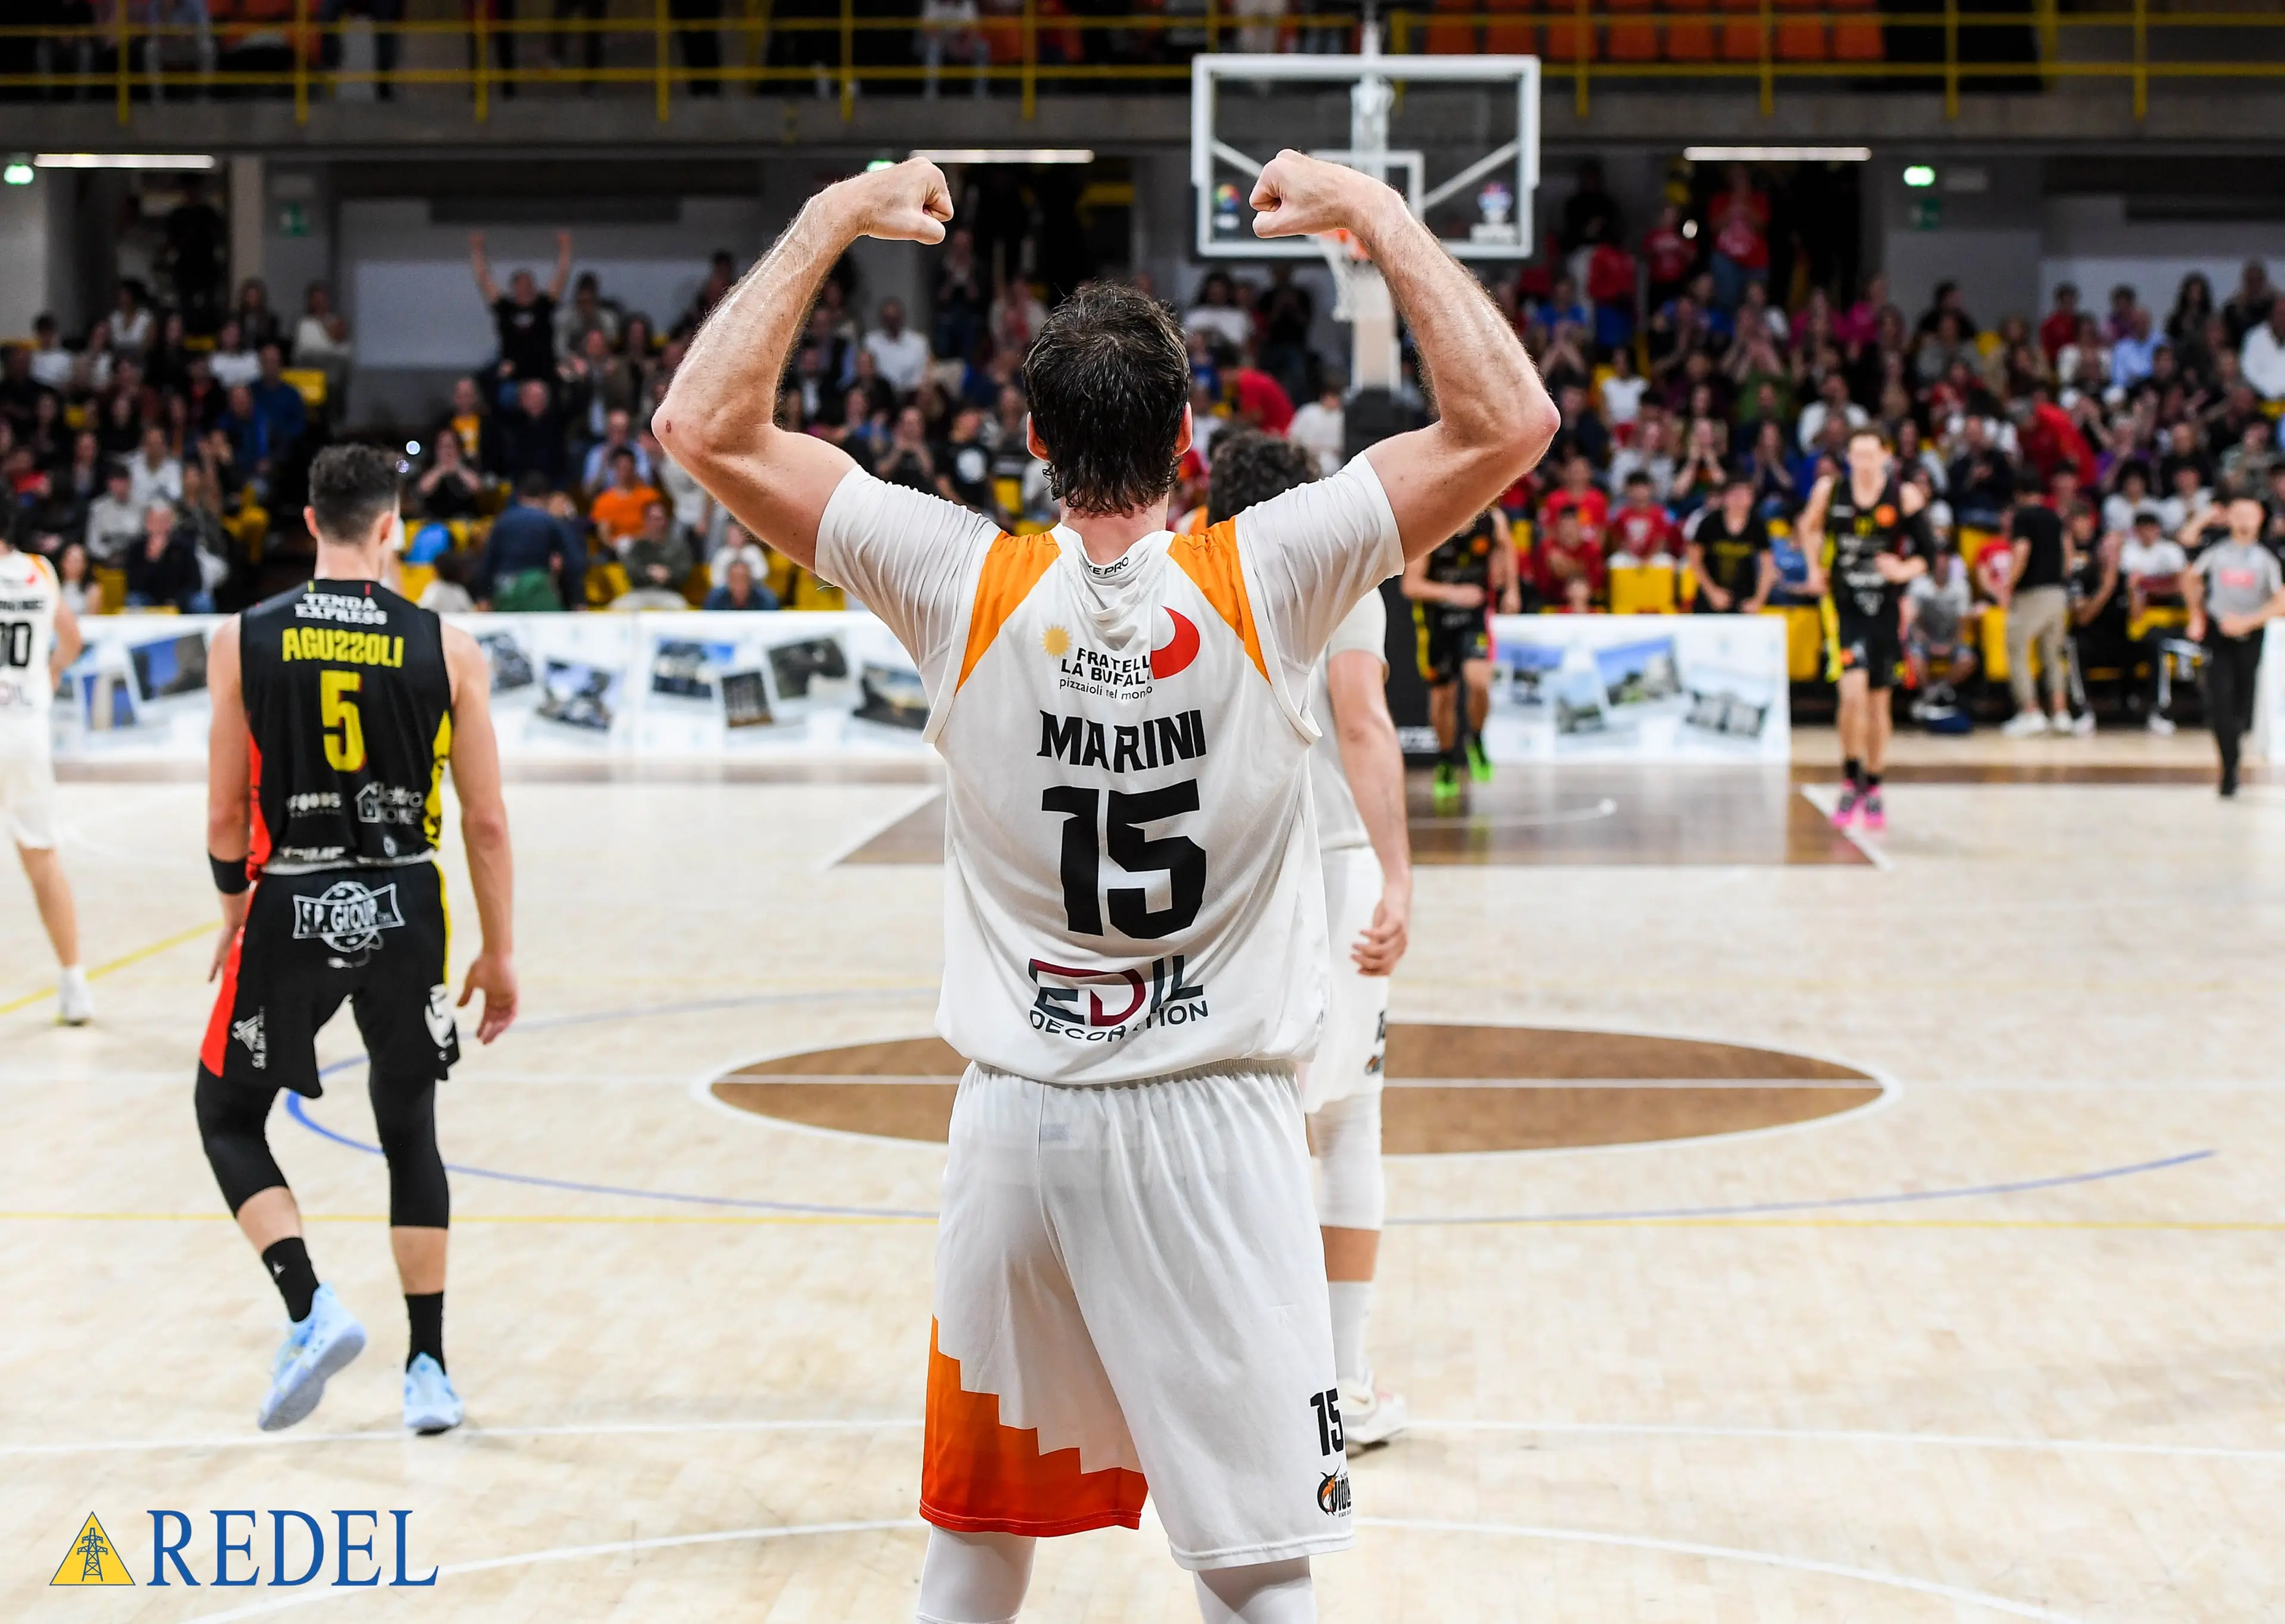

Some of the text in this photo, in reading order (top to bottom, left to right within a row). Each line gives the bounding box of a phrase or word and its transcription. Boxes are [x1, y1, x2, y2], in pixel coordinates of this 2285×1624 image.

[1104, 557, 1128, 575] PRO
[295, 603, 387, 625] EXPRESS
[303, 593, 378, 611] TENDA
[1061, 659, 1150, 687] LA BUFAL
[1076, 647, 1150, 673] FRATELL
[1059, 677, 1102, 696] pizzaioli
[1106, 689, 1118, 699] nel
[320, 670, 367, 772] 5
[1037, 709, 1207, 773] MARINI
[1041, 778, 1207, 940] 15
[1028, 955, 1204, 1027] EDIL
[1029, 1000, 1209, 1042] DECORTION
[1310, 1388, 1344, 1456] 15
